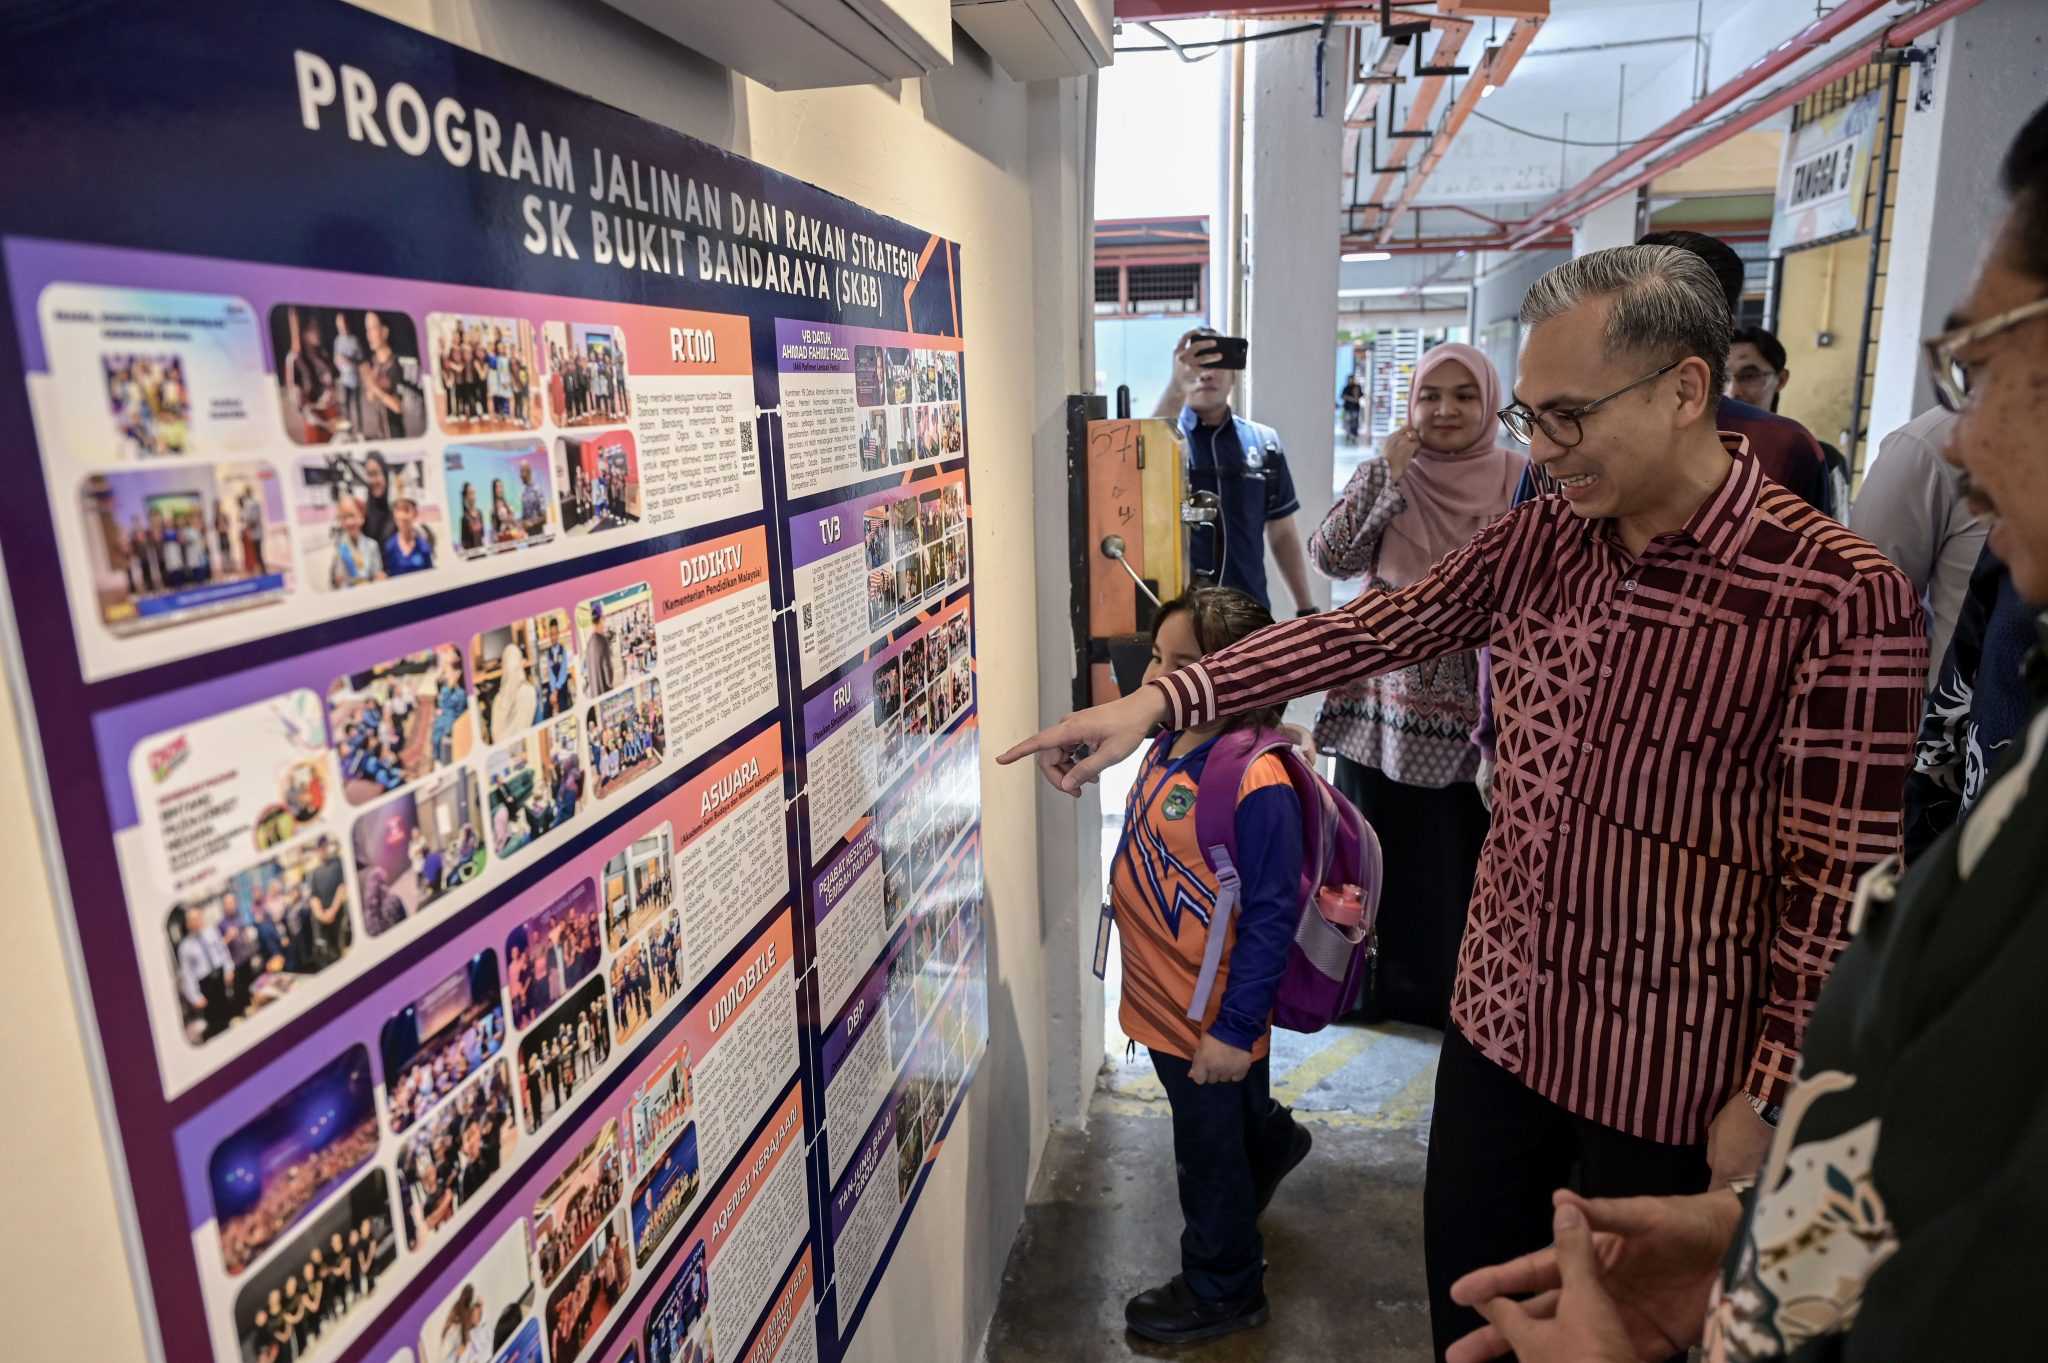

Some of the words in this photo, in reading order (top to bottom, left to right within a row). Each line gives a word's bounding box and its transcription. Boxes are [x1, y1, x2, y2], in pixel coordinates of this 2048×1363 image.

[293, 50, 575, 194] PROGRAM
[590, 147, 722, 231] JALINAN
[732, 192, 778, 246] DAN
[785, 208, 846, 263] RAKAN
[851, 232, 920, 283] STRATEGIK
[523, 196, 580, 261] SK
[592, 212, 686, 277] BUKIT
[699, 235, 831, 301] BANDARAYA
[836, 266, 884, 317] (SKBB)
[670, 327, 716, 363] RTM
[782, 344, 808, 359] AHMAD
[808, 346, 830, 360] FAHMI
[830, 348, 850, 360] FADZIL
[802, 329, 812, 344] YB
[812, 330, 832, 344] DATUK
[819, 516, 841, 545] TV3
[680, 544, 742, 588] DIDIKTV
[662, 590, 705, 614] (Kementerian
[706, 576, 737, 596] Pendidikan
[738, 567, 762, 584] Malaysia)
[834, 681, 850, 714] FRU
[701, 757, 760, 818] ASWARA
[819, 858, 846, 898] PEJABAT
[826, 868, 852, 906] LEMBAH
[852, 844, 874, 877] PANTAI
[709, 941, 777, 1033] UMOBILE
[848, 998, 864, 1037] DBP
[712, 1172, 752, 1242] AGENSI
[752, 1105, 798, 1180] KERAJAAN
[838, 1147, 872, 1210] TANJUNG
[873, 1112, 891, 1150] BALAI
[856, 1150, 878, 1197] GROUP
[768, 1263, 808, 1335] MALAYSIA
[761, 1303, 793, 1363] NBARU
